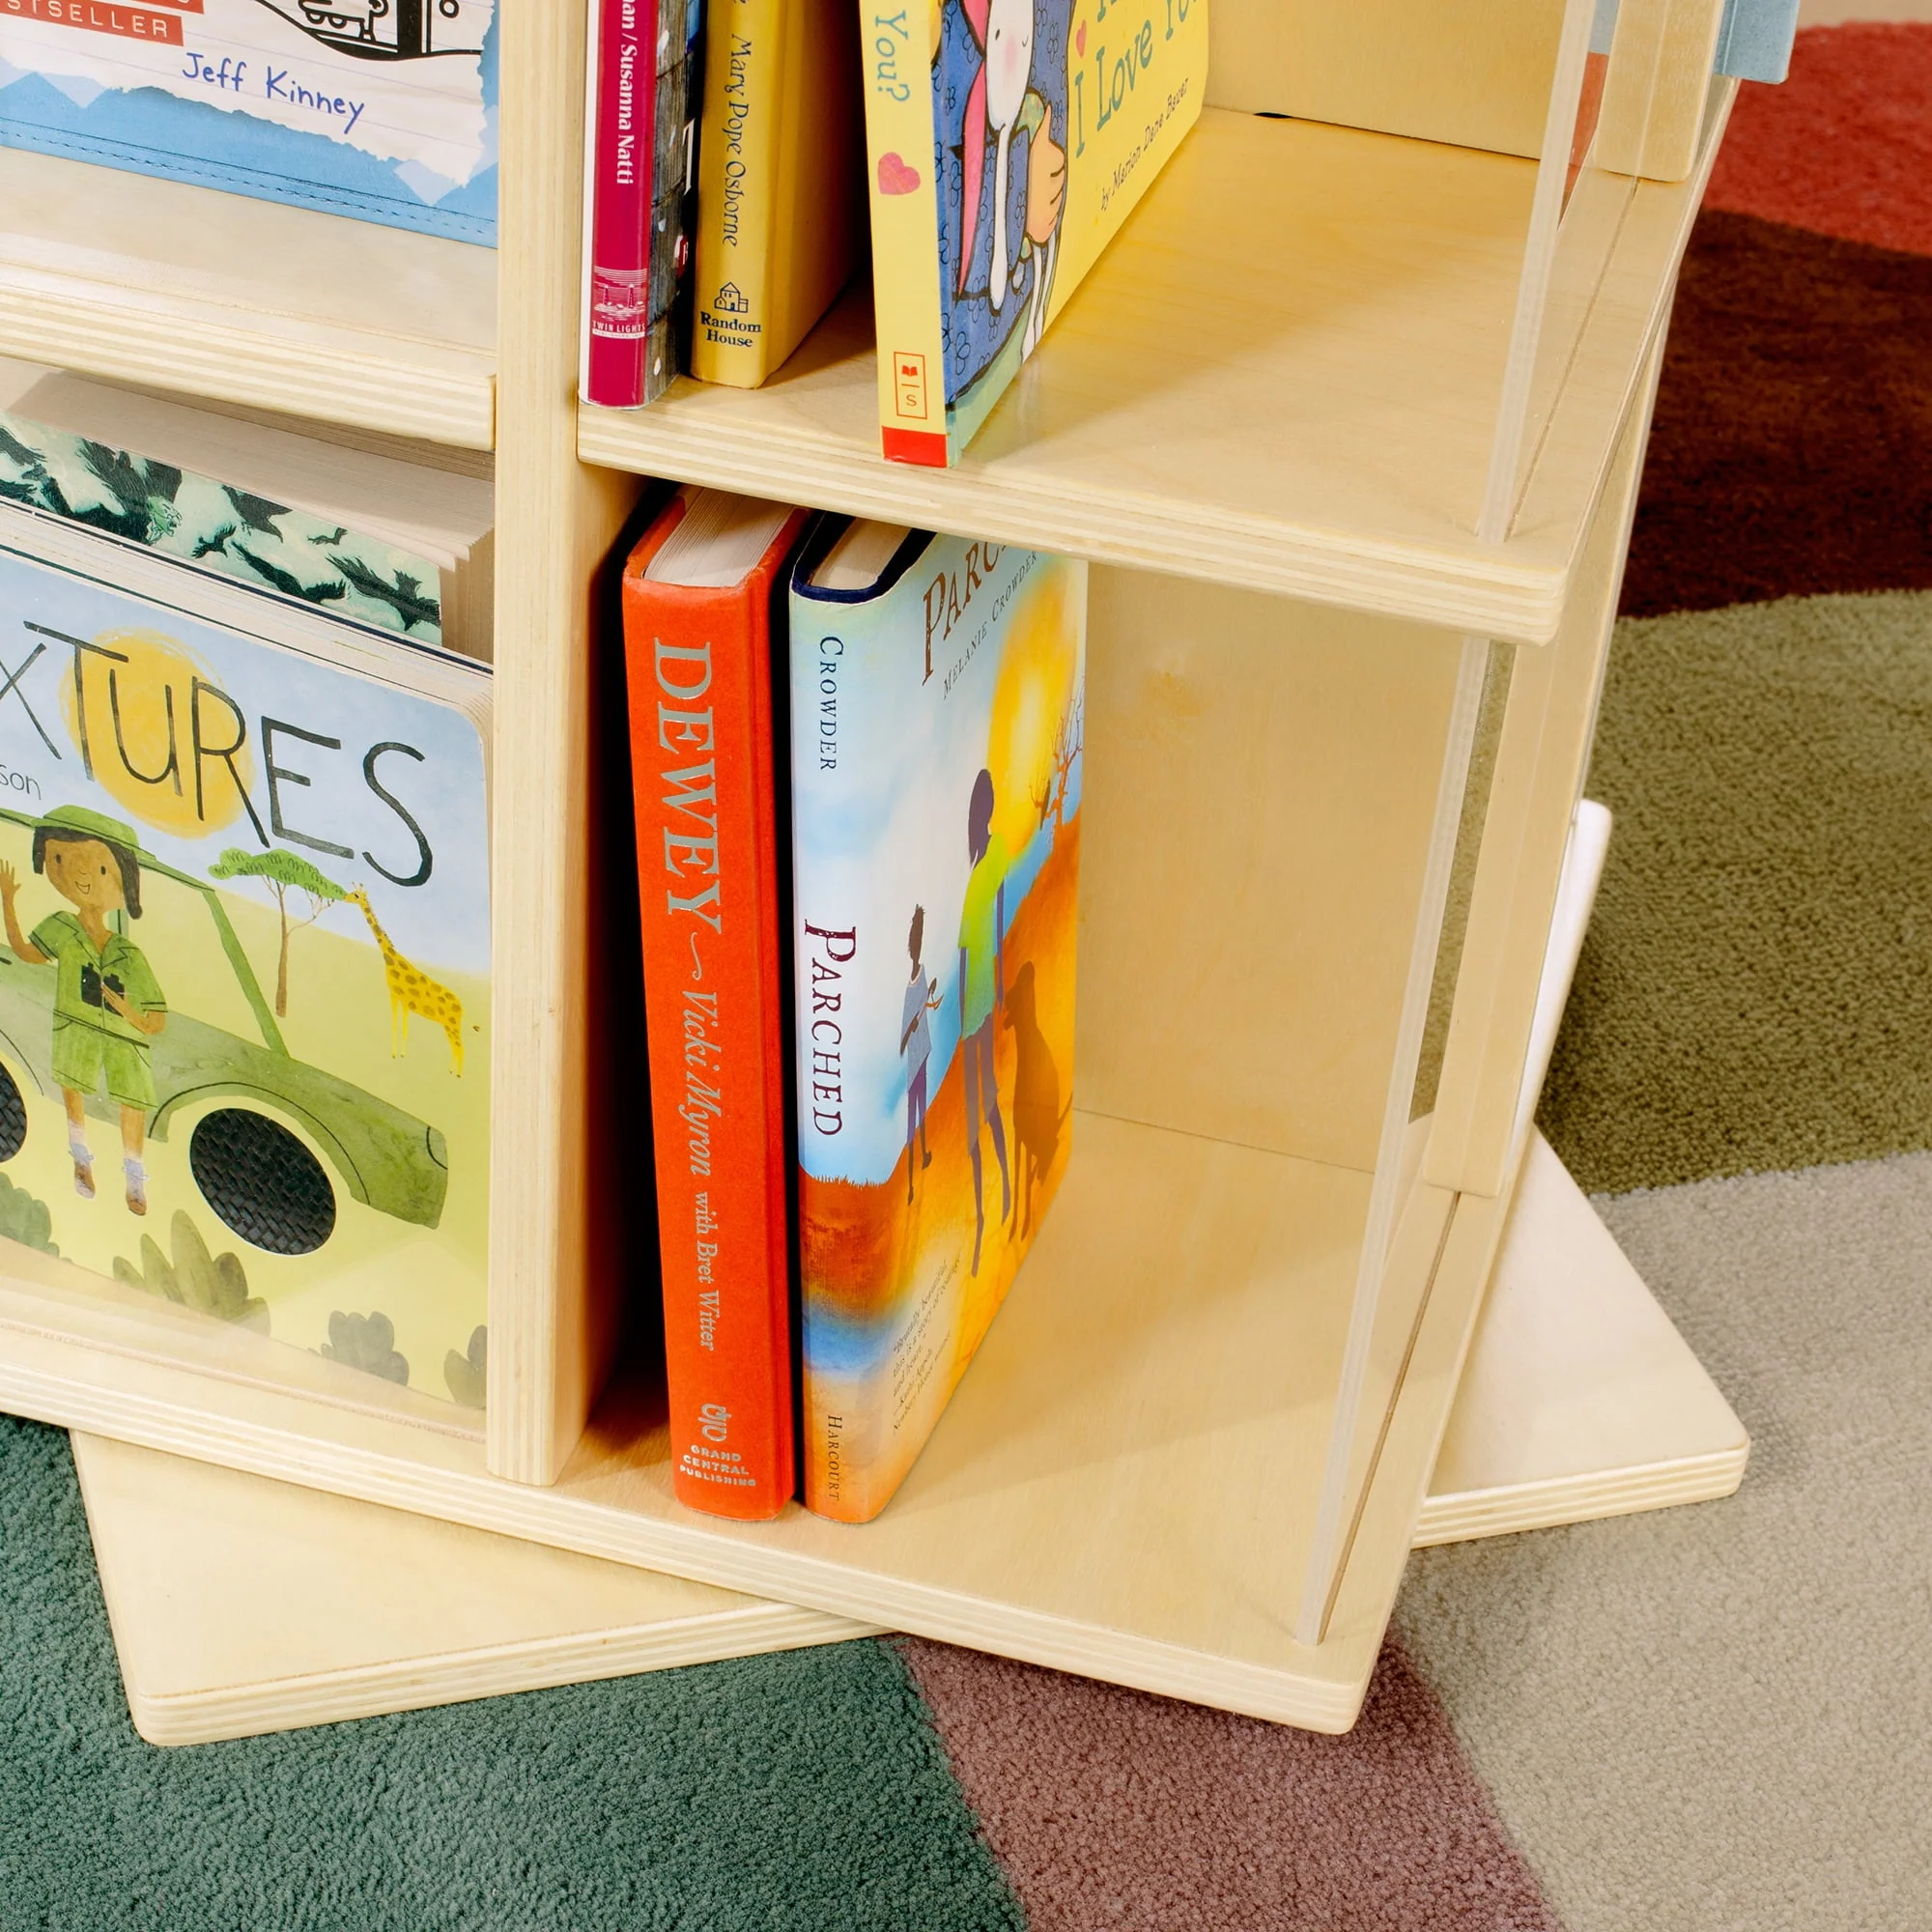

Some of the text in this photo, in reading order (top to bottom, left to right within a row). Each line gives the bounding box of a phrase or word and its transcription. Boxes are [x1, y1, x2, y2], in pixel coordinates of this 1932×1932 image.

[183, 51, 365, 134] Jeff Kinney
[618, 43, 638, 130] Susanna
[724, 34, 753, 97] Mary
[875, 10, 911, 102] You?
[1074, 71, 1085, 158] I
[1095, 19, 1153, 131] Love
[616, 132, 634, 185] Natti
[722, 101, 750, 157] Pope
[1111, 146, 1141, 197] Marion
[722, 160, 747, 248] Osborne
[592, 321, 646, 333] TWIN LIGHTS
[700, 311, 761, 333] Random
[706, 328, 753, 348] House
[922, 541, 1007, 687] PARC
[943, 551, 1037, 700] MELANIE CROWDER
[819, 636, 844, 771] CROWDER
[654, 637, 722, 934] DEWEY
[805, 919, 857, 1136] PARCHED
[678, 990, 722, 1351] Vicki Myron with Bret Witter
[679, 1464, 756, 1487] PUBLISHING
[682, 1454, 750, 1476] CENTRAL
[690, 1444, 742, 1463] GRAND
[828, 1414, 842, 1501] HARCOURT
